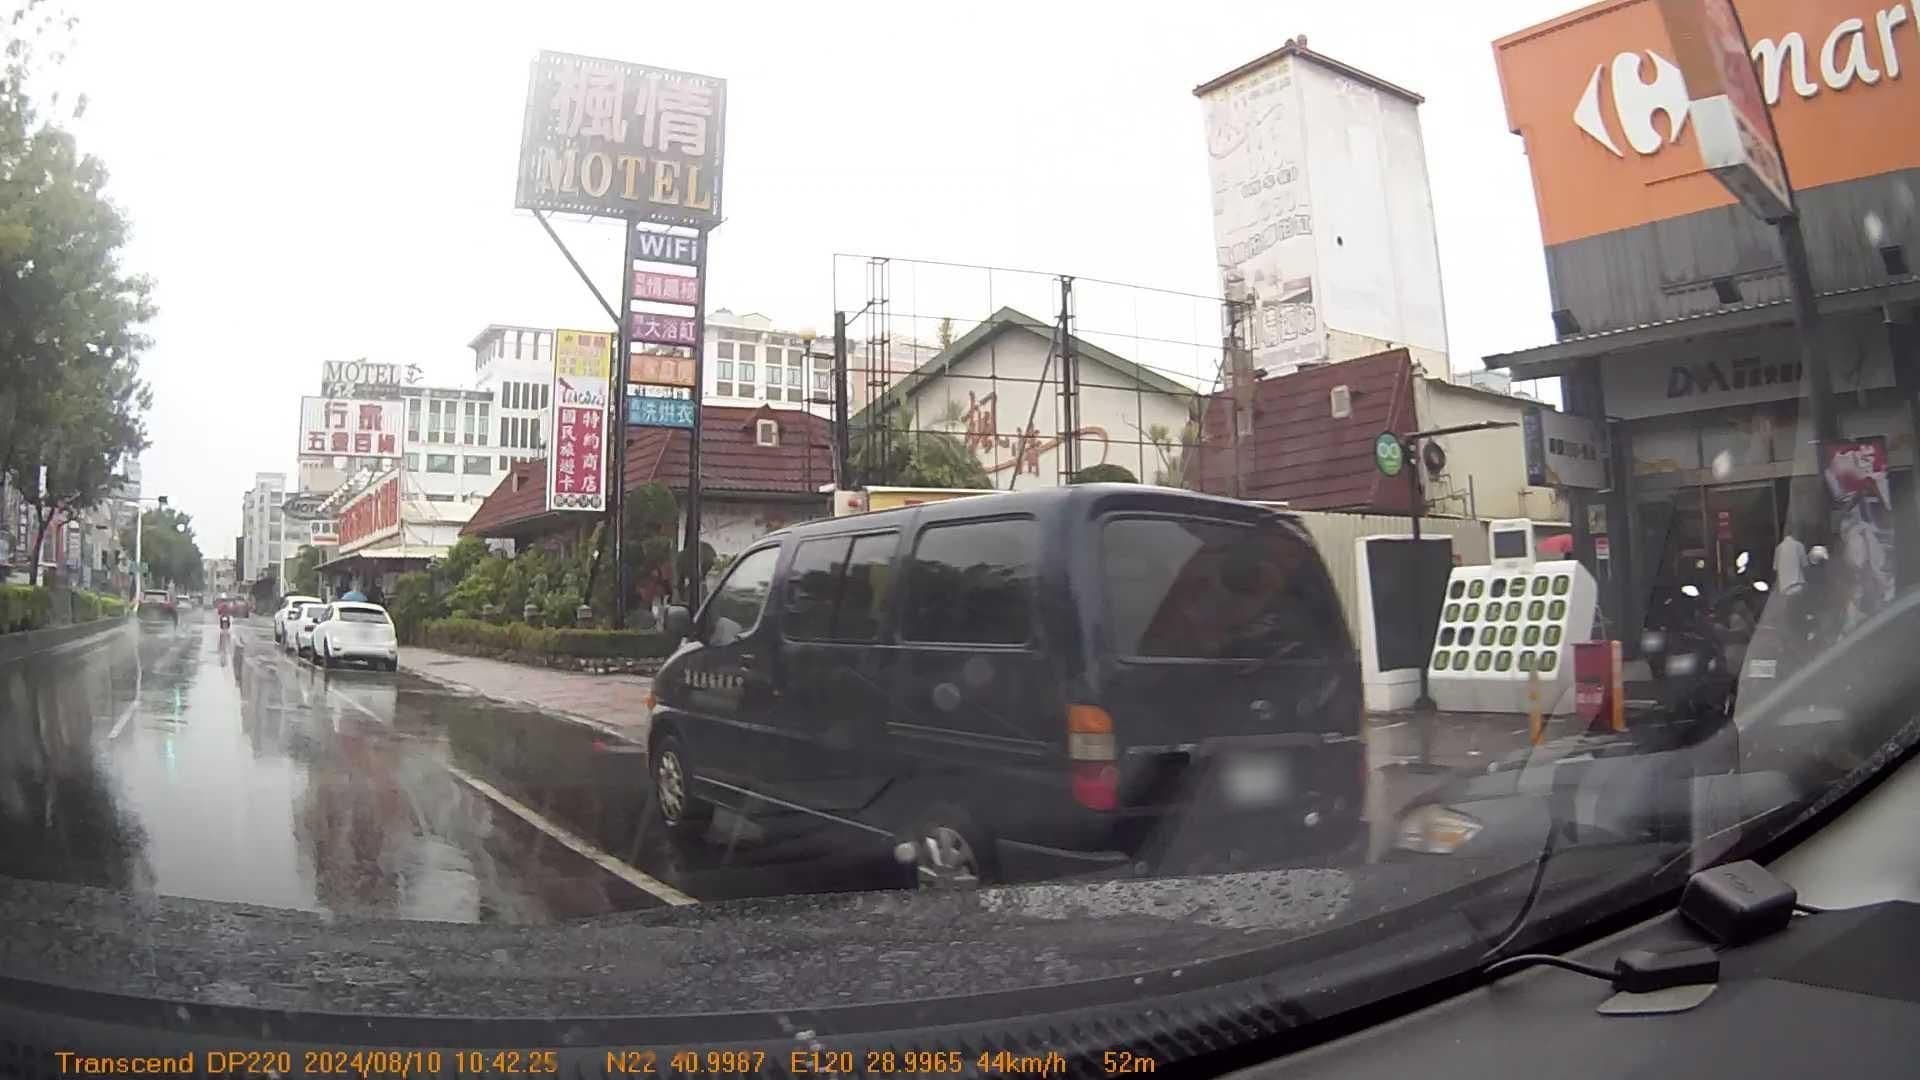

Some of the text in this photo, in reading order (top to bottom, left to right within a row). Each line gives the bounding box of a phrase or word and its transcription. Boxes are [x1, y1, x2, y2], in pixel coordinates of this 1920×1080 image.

[1751, 0, 1920, 106] mar
[537, 145, 712, 210] MOTEL
[324, 360, 401, 385] MOTEL
[559, 408, 577, 492] 國民旅遊卡
[581, 409, 601, 492] 特約商店
